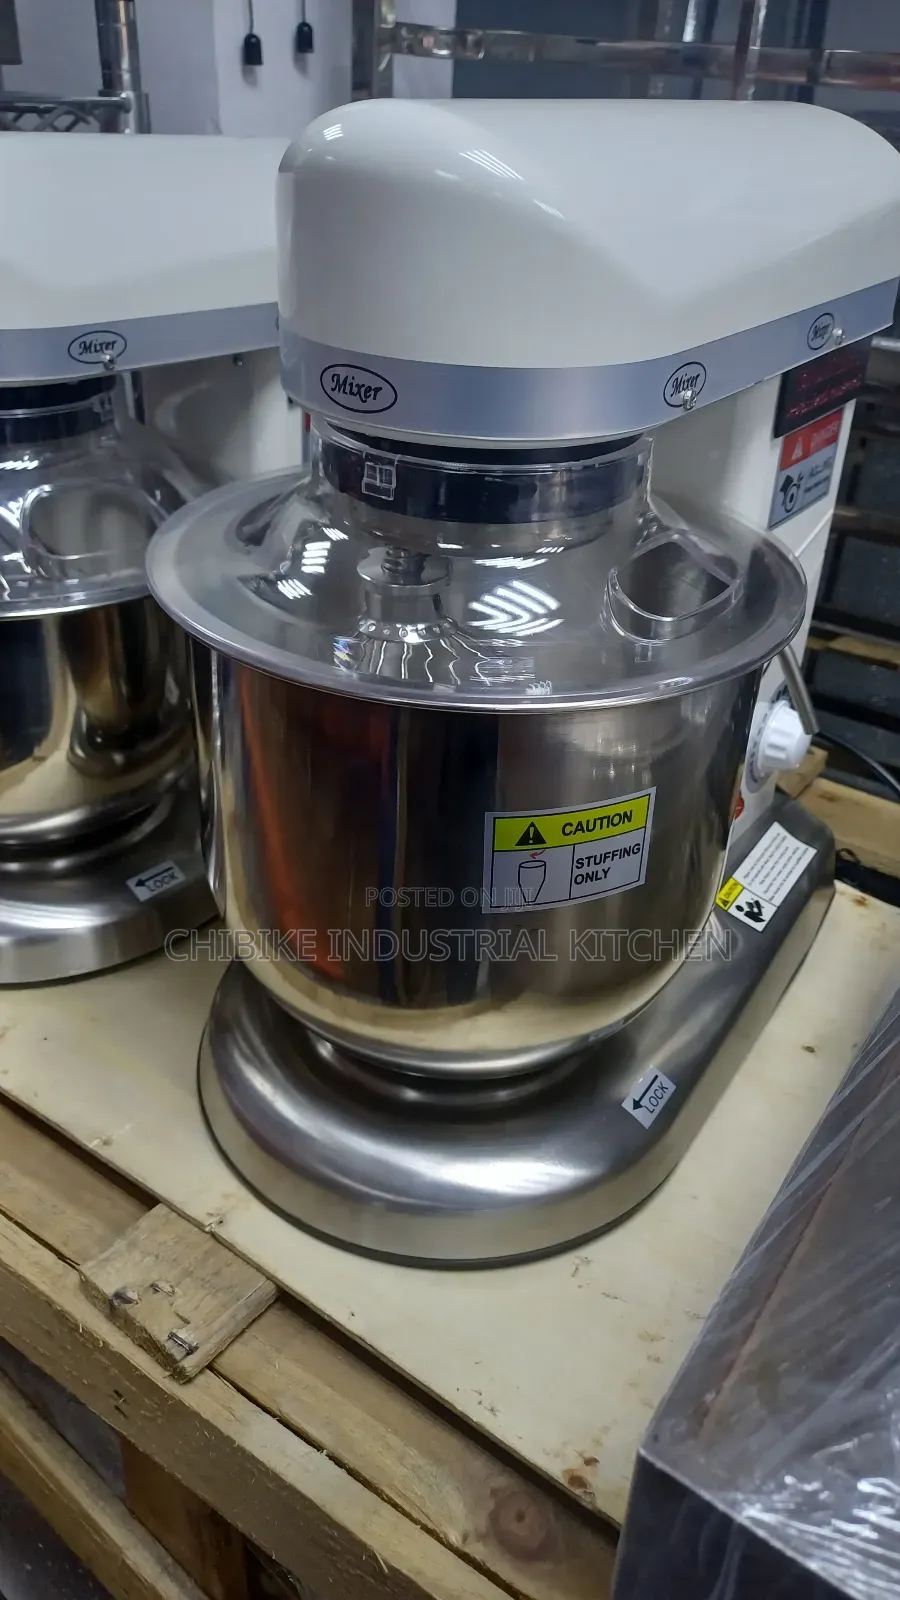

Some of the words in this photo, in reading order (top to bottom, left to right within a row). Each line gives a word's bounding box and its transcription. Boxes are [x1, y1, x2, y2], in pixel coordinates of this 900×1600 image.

[78, 338, 118, 356] Mixer
[331, 373, 383, 403] Mixer
[670, 373, 701, 398] Mixer
[561, 809, 633, 837] CAUTION
[575, 843, 641, 870] STUFFING
[147, 871, 180, 892] LOCK
[574, 867, 611, 885] ONLY
[643, 1080, 669, 1114] LOCK
